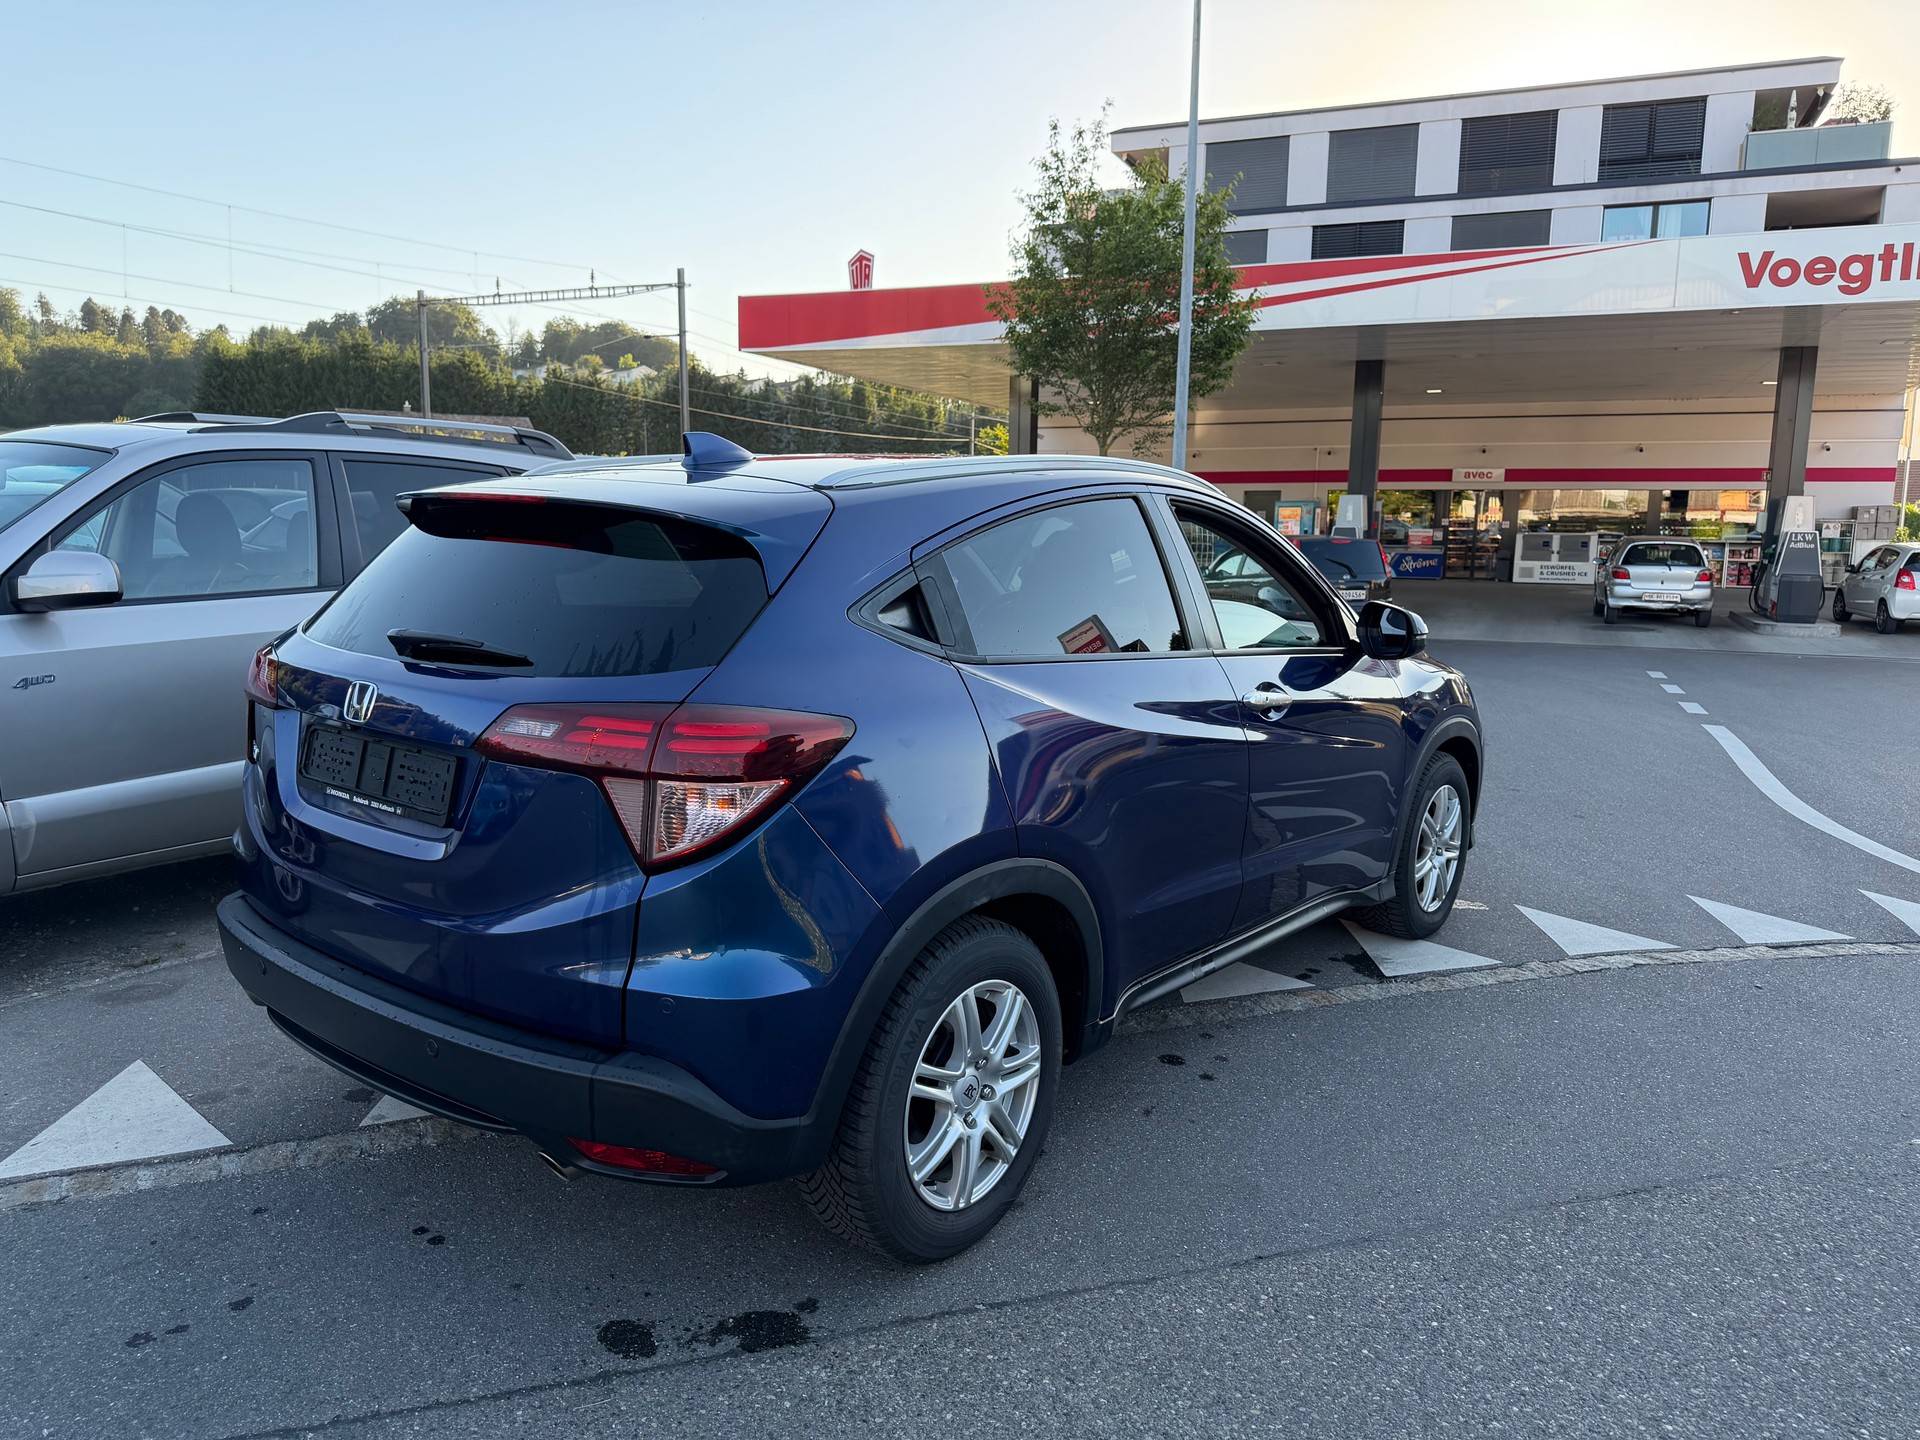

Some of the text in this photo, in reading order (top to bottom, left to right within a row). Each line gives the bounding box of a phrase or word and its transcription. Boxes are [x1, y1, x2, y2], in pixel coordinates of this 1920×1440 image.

[1737, 242, 1920, 296] Voegtl
[1463, 471, 1493, 479] avec
[1791, 533, 1815, 541] LKW
[1789, 541, 1815, 549] AdBlue
[12, 673, 56, 690] 4WD
[331, 789, 350, 799] HONDA
